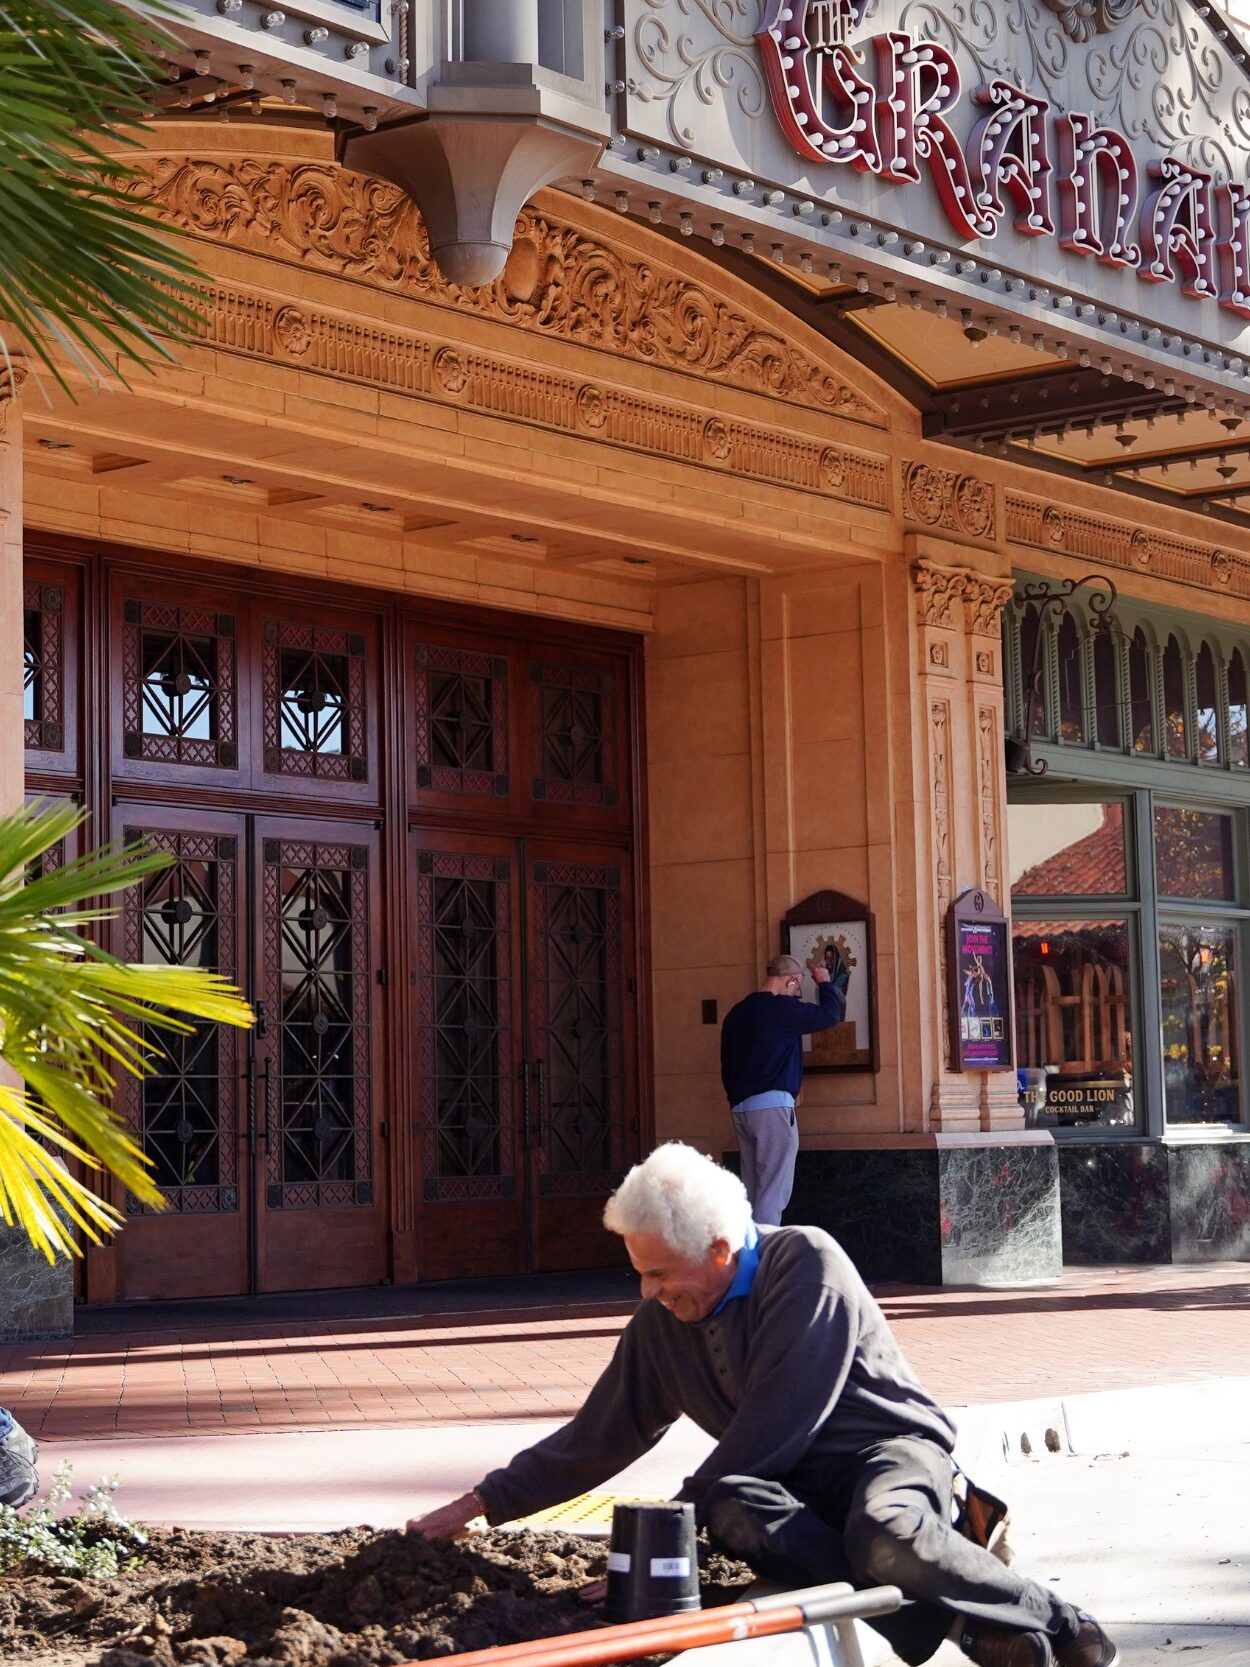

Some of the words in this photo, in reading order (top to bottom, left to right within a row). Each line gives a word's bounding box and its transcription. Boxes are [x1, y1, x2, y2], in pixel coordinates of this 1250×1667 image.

[812, 0, 866, 64] THE
[1050, 1090, 1083, 1103] GOOD
[1086, 1089, 1115, 1102] LION
[1045, 1105, 1079, 1113] COCKTAIL
